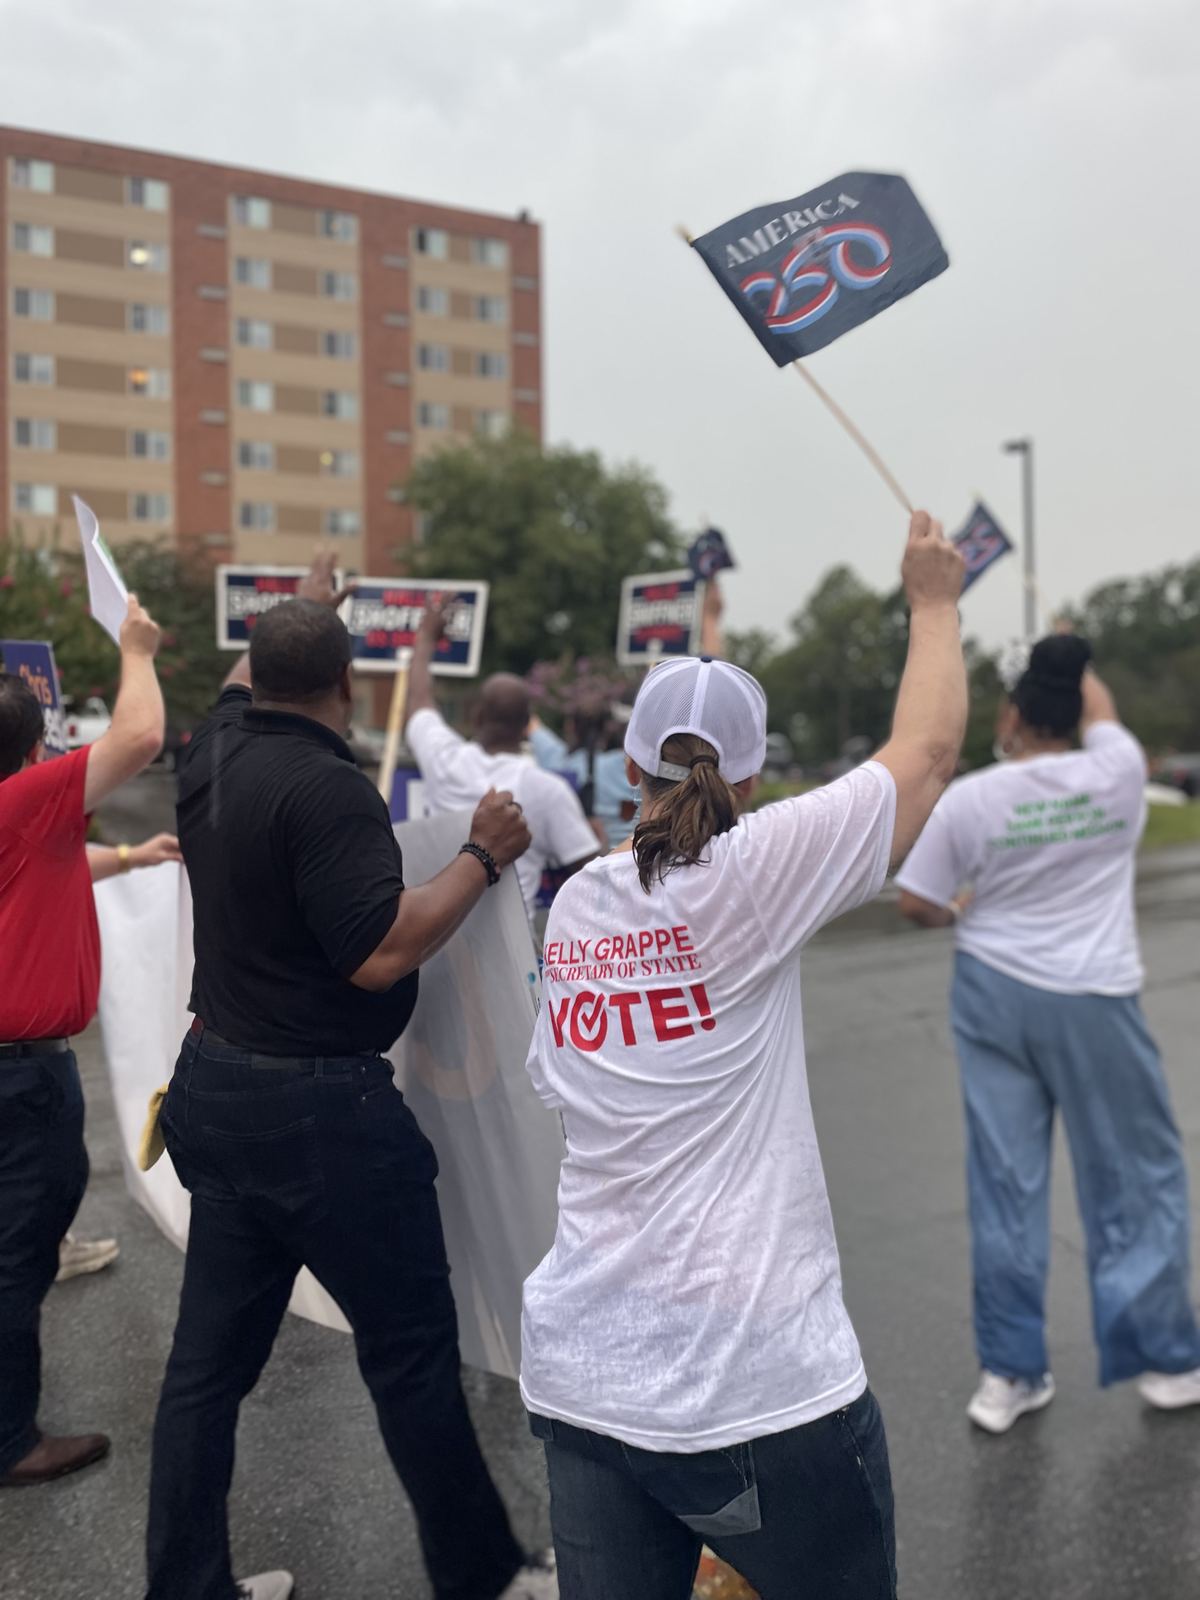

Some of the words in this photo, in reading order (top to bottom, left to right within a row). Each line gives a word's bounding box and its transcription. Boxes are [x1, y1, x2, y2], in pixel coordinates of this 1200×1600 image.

[727, 192, 860, 269] AMERICA
[739, 219, 894, 336] 250
[550, 962, 615, 984] SECRETARY
[617, 960, 637, 979] OF
[641, 953, 702, 977] STATE
[594, 925, 695, 961] GRAPPE
[548, 983, 716, 1052] VOTE!
